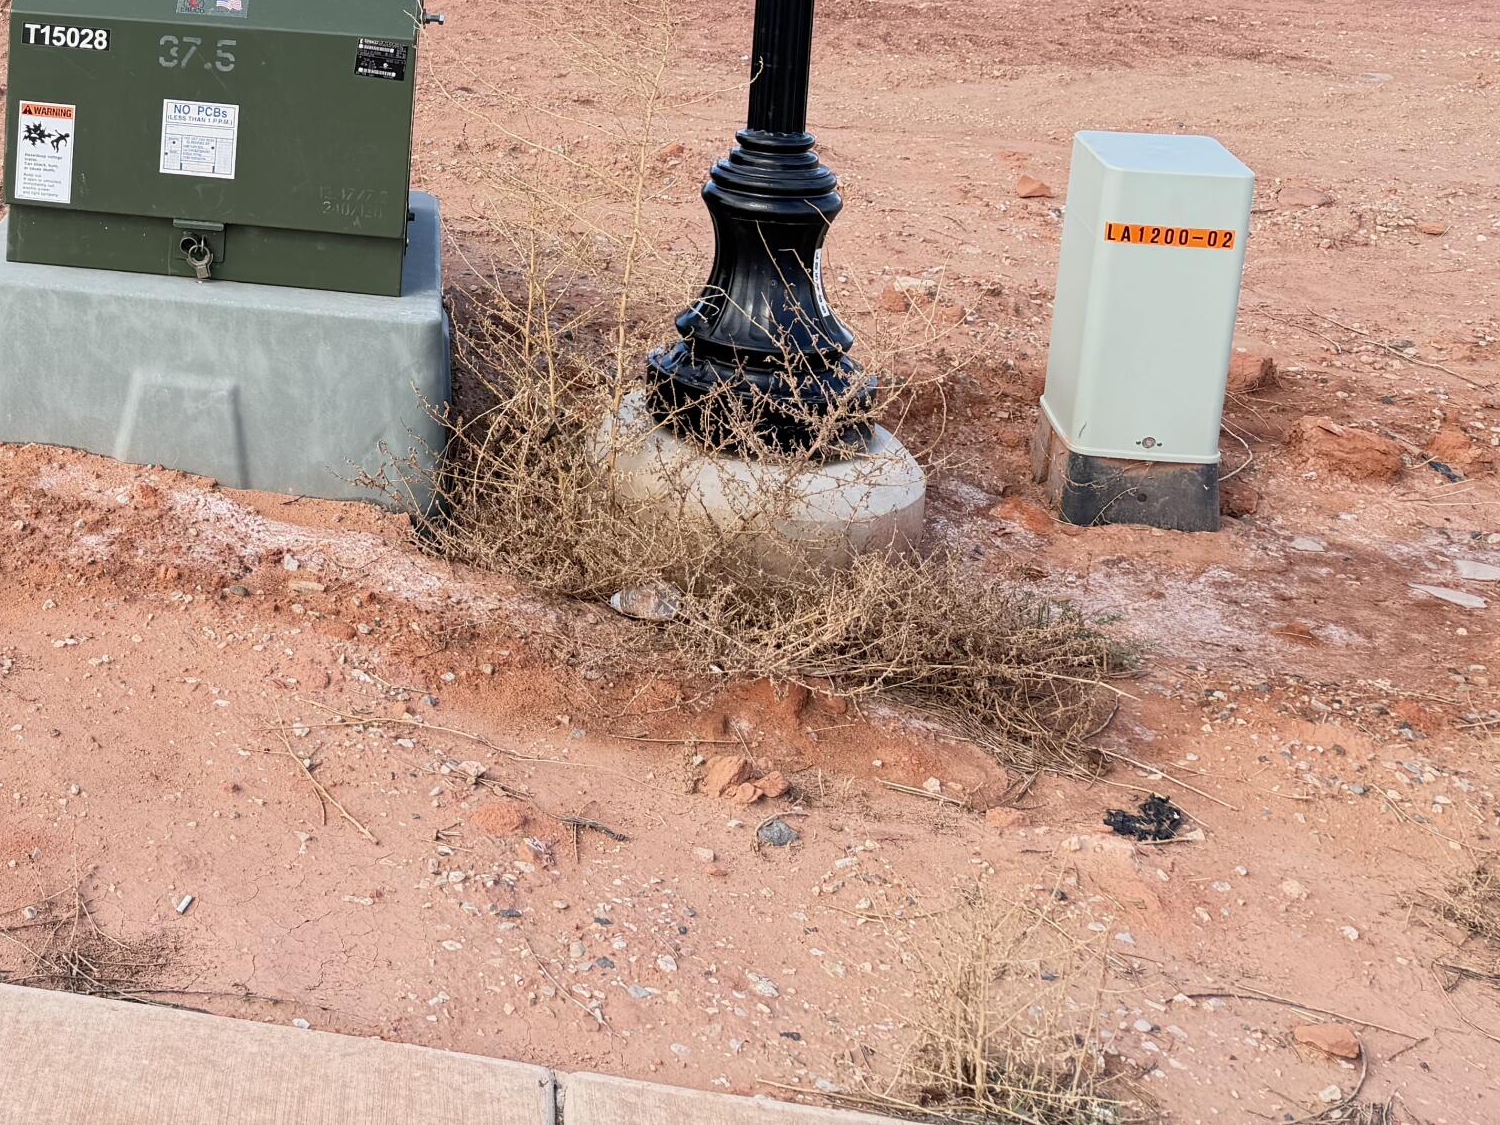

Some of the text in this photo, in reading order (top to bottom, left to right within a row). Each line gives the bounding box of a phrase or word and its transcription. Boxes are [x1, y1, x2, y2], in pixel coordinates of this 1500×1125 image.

[25, 23, 108, 50] T15028
[158, 35, 237, 72] 37.5
[33, 106, 72, 118] WARNING
[173, 104, 228, 118] NO PCBs
[1106, 223, 1233, 248] LA1200-02
